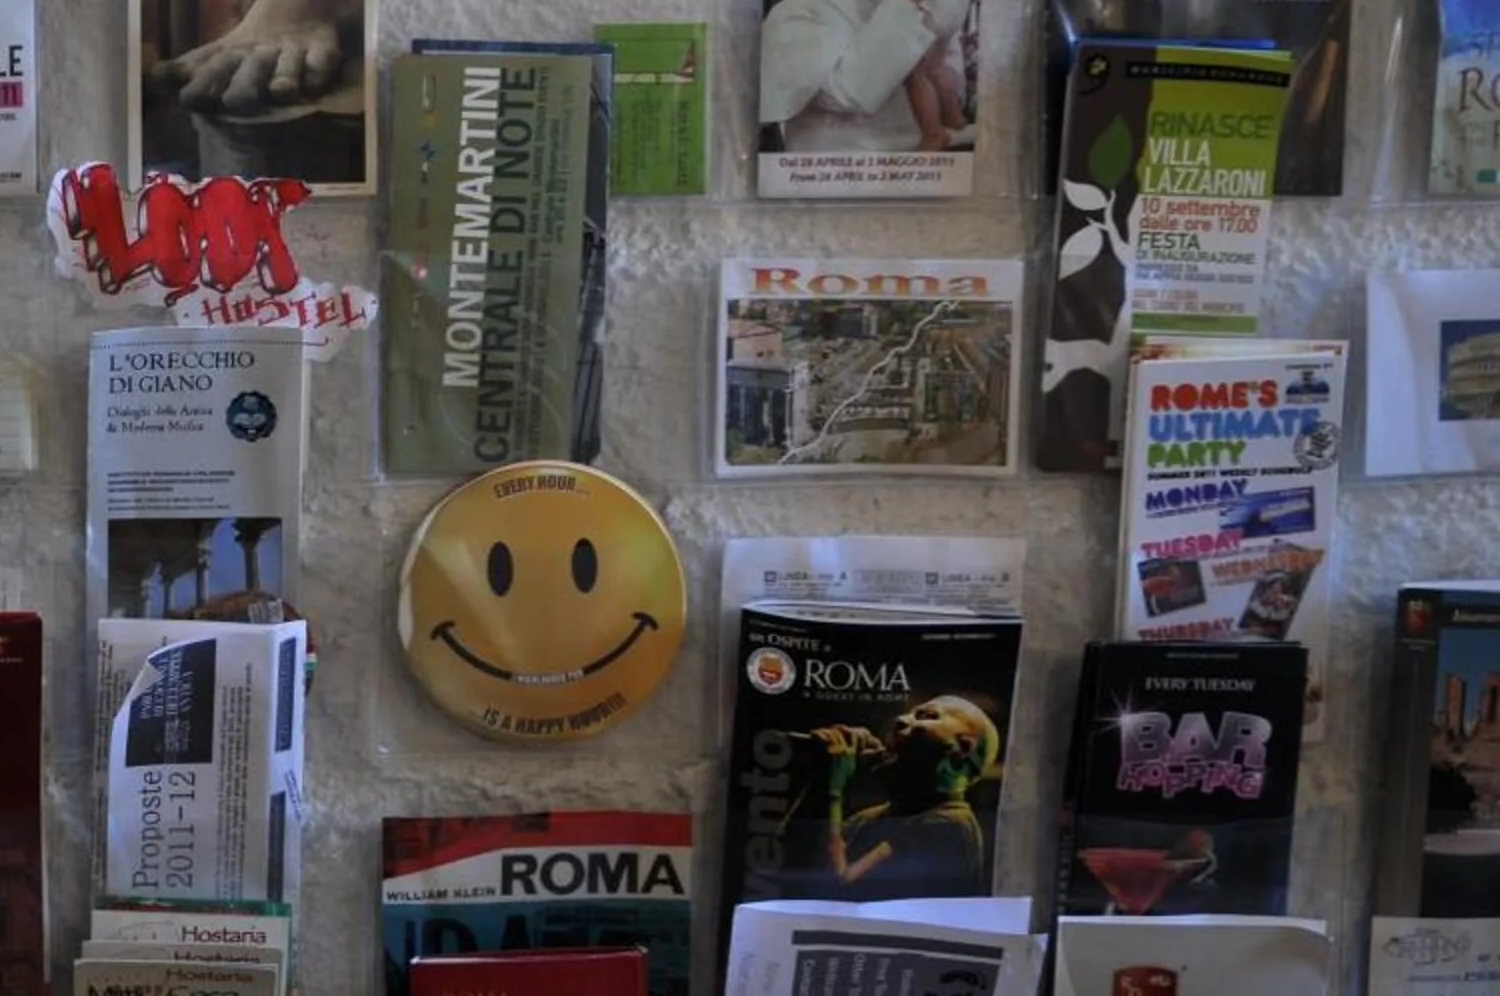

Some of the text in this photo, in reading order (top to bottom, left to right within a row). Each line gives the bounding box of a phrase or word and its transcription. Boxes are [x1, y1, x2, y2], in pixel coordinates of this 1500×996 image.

[497, 66, 537, 181] NOTE
[1150, 110, 1275, 140] RINASCE
[1149, 137, 1212, 166] VILLA
[1143, 166, 1267, 197] LAZZARONI
[491, 192, 528, 236] DI
[1165, 200, 1261, 218] settembre
[442, 66, 501, 389] MONTEMARTINI
[1137, 232, 1201, 251] FESTA
[1184, 220, 1212, 232] ore
[749, 266, 993, 298] Roma
[108, 351, 256, 373] L'ORECCHIO
[473, 249, 525, 463] CENTRALE
[108, 375, 214, 395] DI GIANO
[1150, 380, 1278, 412] ROME'S
[1148, 407, 1320, 442] ULTIMATE
[1147, 441, 1246, 470] PARTY
[493, 476, 536, 499] EVERY
[1145, 478, 1248, 512] MONDAY
[1140, 526, 1245, 560] TUESDAY
[766, 634, 821, 652] OSPITE
[803, 658, 912, 692] ROMA
[1144, 675, 1257, 693] EVERY TUESDAY
[483, 707, 567, 736] IS A HAPPY
[1118, 710, 1274, 771] BAR
[1116, 761, 1268, 801] HOPPING
[132, 770, 163, 891] Proposte
[165, 769, 197, 889] 2011-12
[386, 852, 685, 902] WILLIAM KLEIN ROMA
[181, 925, 267, 945] Hostaria
